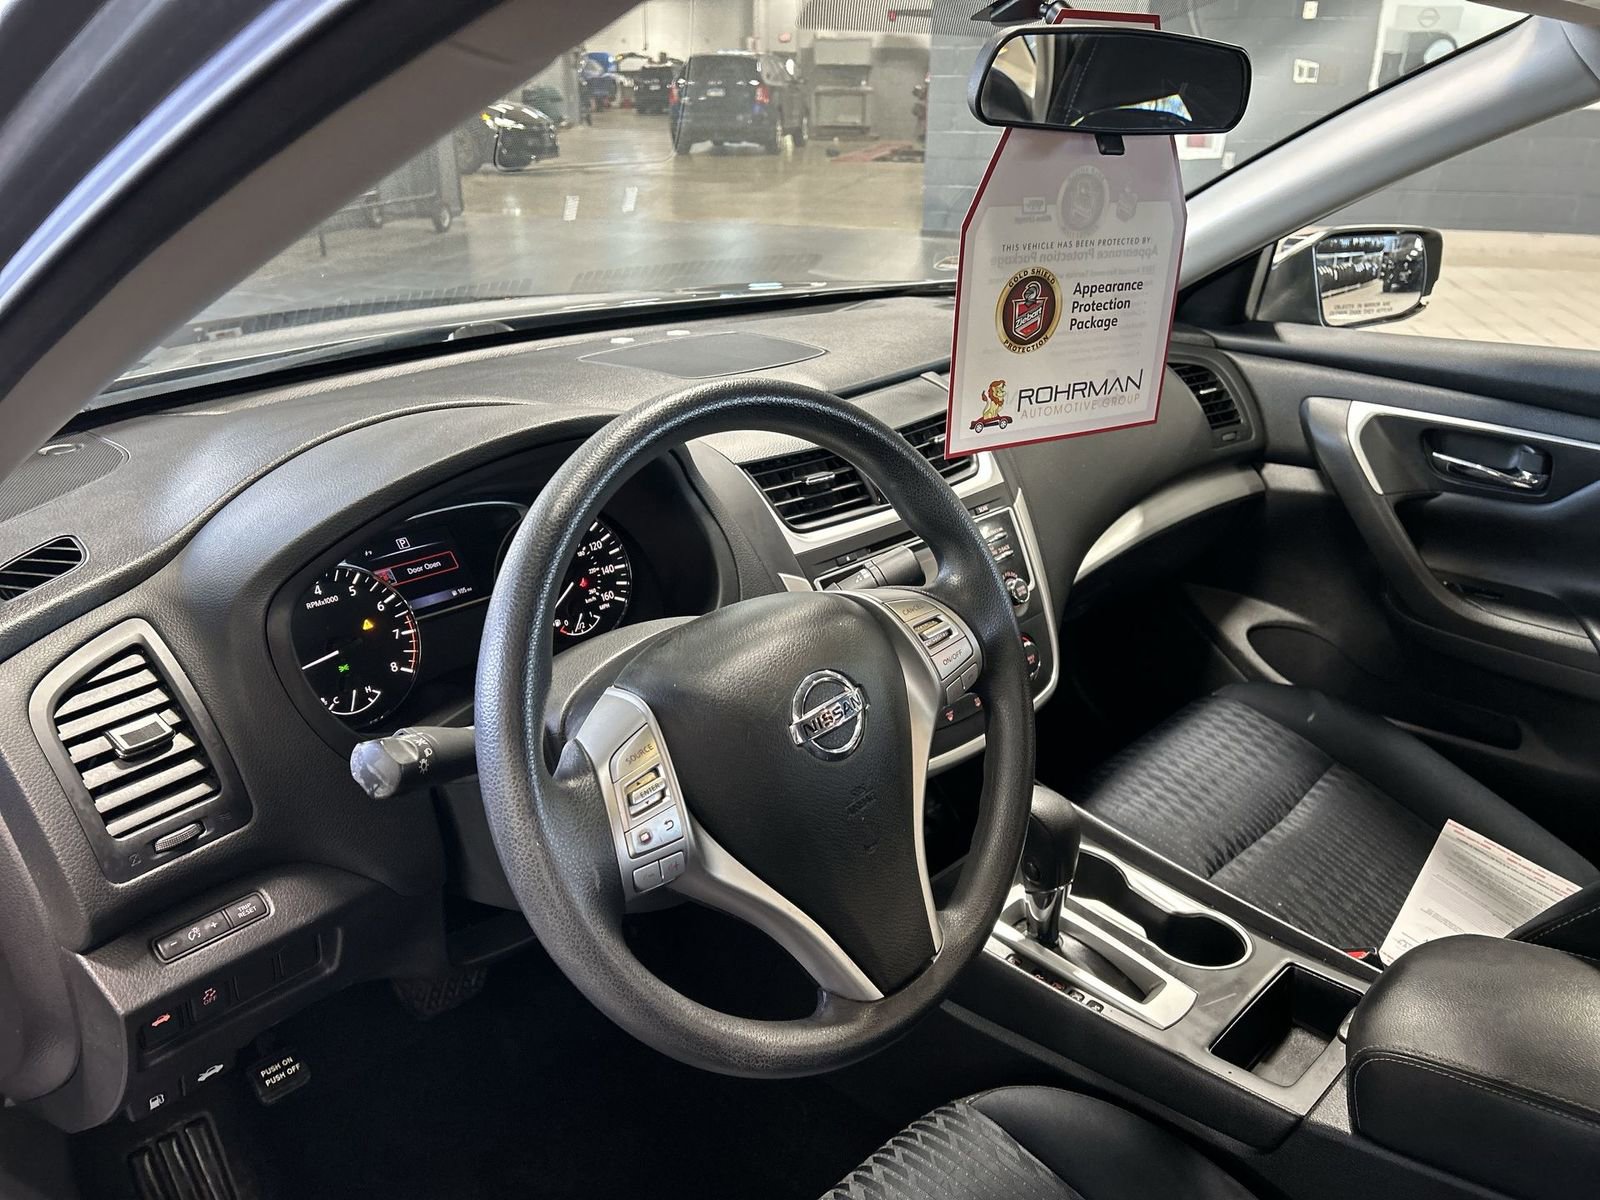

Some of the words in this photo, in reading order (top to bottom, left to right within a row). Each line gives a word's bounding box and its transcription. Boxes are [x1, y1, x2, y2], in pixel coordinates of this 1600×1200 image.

[1002, 244, 1019, 252] THIS
[1023, 241, 1054, 251] VEHICLE
[1057, 240, 1073, 249] HAS
[1075, 239, 1095, 248] BEEN
[1097, 237, 1140, 247] PROTECTED
[1009, 270, 1028, 288] GOLD
[1031, 268, 1056, 285] SHIELD
[1073, 281, 1144, 298] Appearance
[1071, 297, 1131, 313] Protection
[1069, 315, 1118, 331] Package
[1004, 335, 1049, 353] PROTECTION
[1017, 368, 1143, 412] ROHRMAN
[1020, 400, 1097, 419] AUTOMOTIVE
[1101, 393, 1140, 409] GROUP
[588, 540, 603, 551] 120
[407, 566, 424, 575] Door
[425, 561, 441, 570] Open
[601, 564, 615, 575] 140
[314, 584, 322, 595] 4
[348, 585, 357, 596] 5
[601, 590, 615, 601] 160
[306, 595, 339, 610] RPMx1000
[377, 602, 385, 612] 6
[392, 628, 400, 640] 7
[942, 648, 963, 666] ON/OFF
[390, 661, 398, 672] 8
[364, 685, 371, 693] H
[333, 696, 340, 704] C
[803, 692, 862, 738] NISSAN
[626, 743, 654, 765] SOURCE
[640, 783, 660, 798] ENTER
[237, 902, 252, 911] TRIP
[237, 905, 257, 918] RESET
[260, 1063, 281, 1078] PUSH
[281, 1056, 293, 1066] ON
[265, 1071, 286, 1087] PUSH
[286, 1062, 300, 1075] OFF
